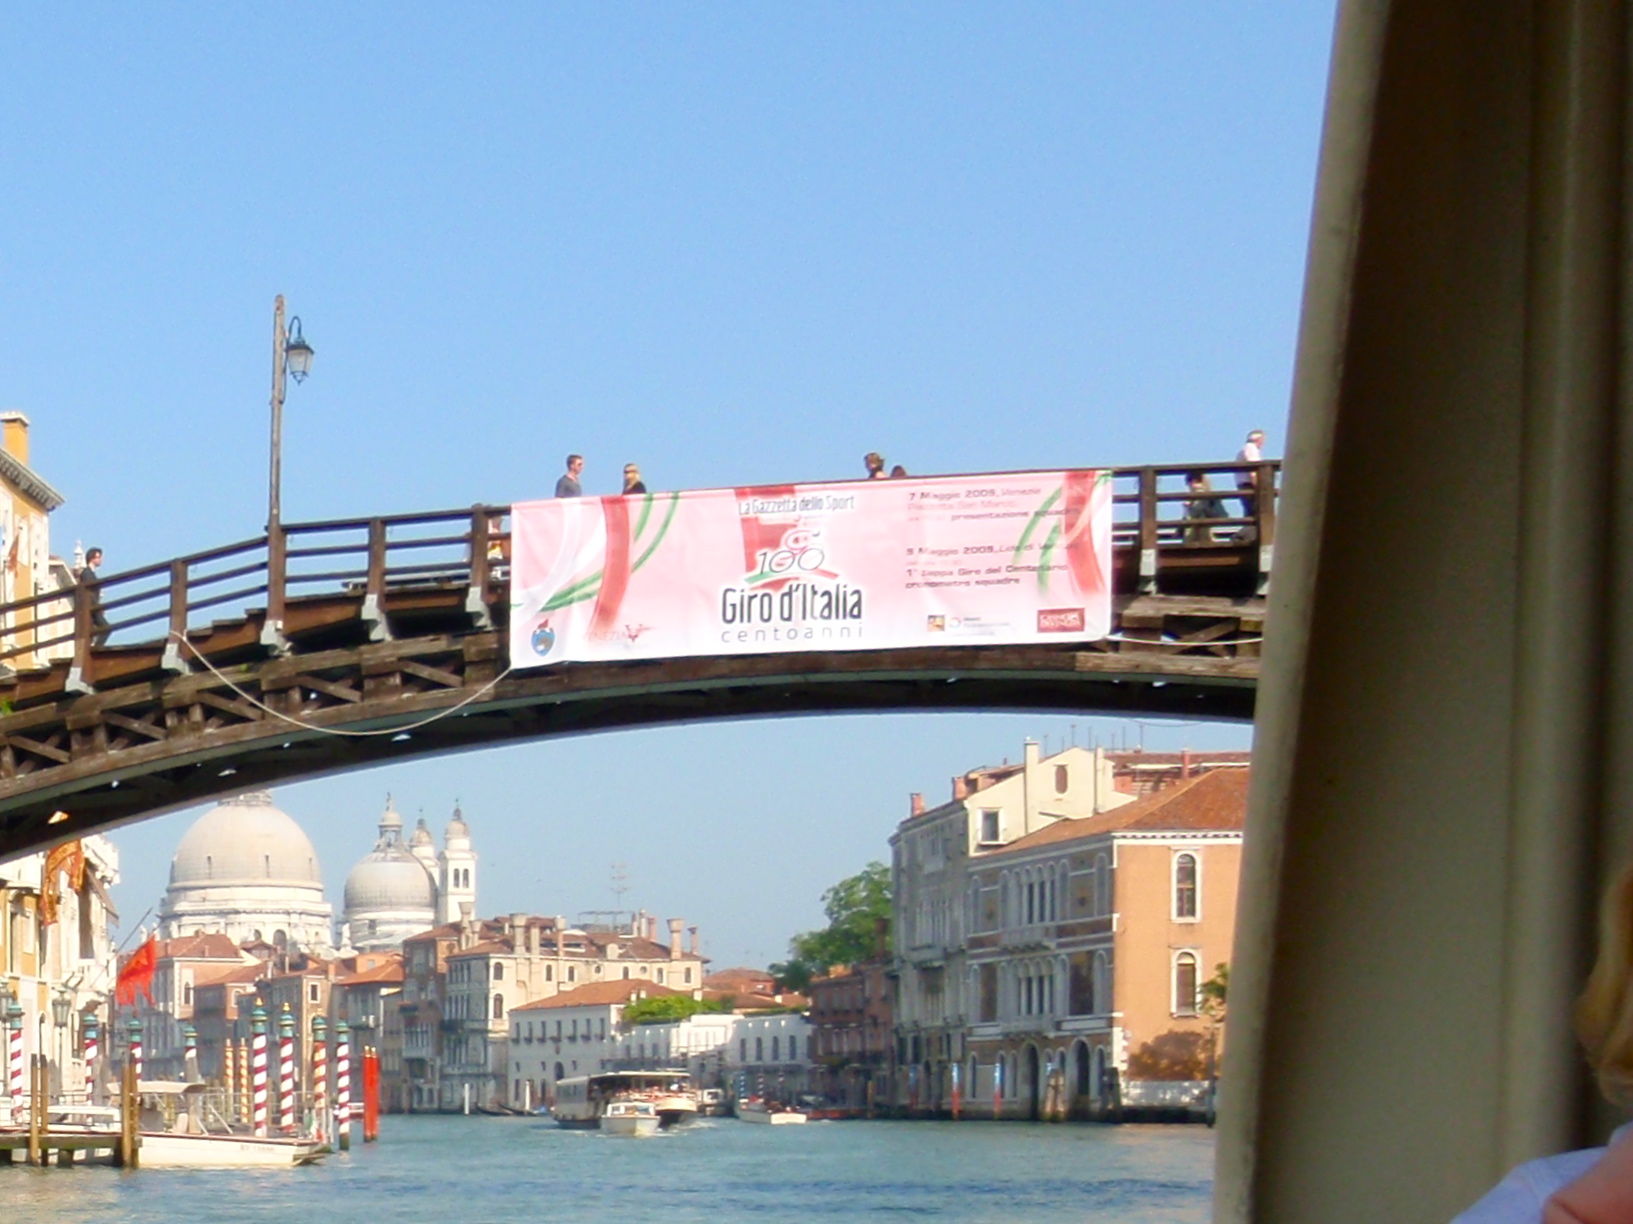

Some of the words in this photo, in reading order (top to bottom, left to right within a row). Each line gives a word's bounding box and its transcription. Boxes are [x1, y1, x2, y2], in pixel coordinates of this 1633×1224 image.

[799, 496, 824, 511] dello
[825, 495, 855, 512] Sport
[722, 588, 773, 624] Giro
[779, 583, 863, 621] d'Italia
